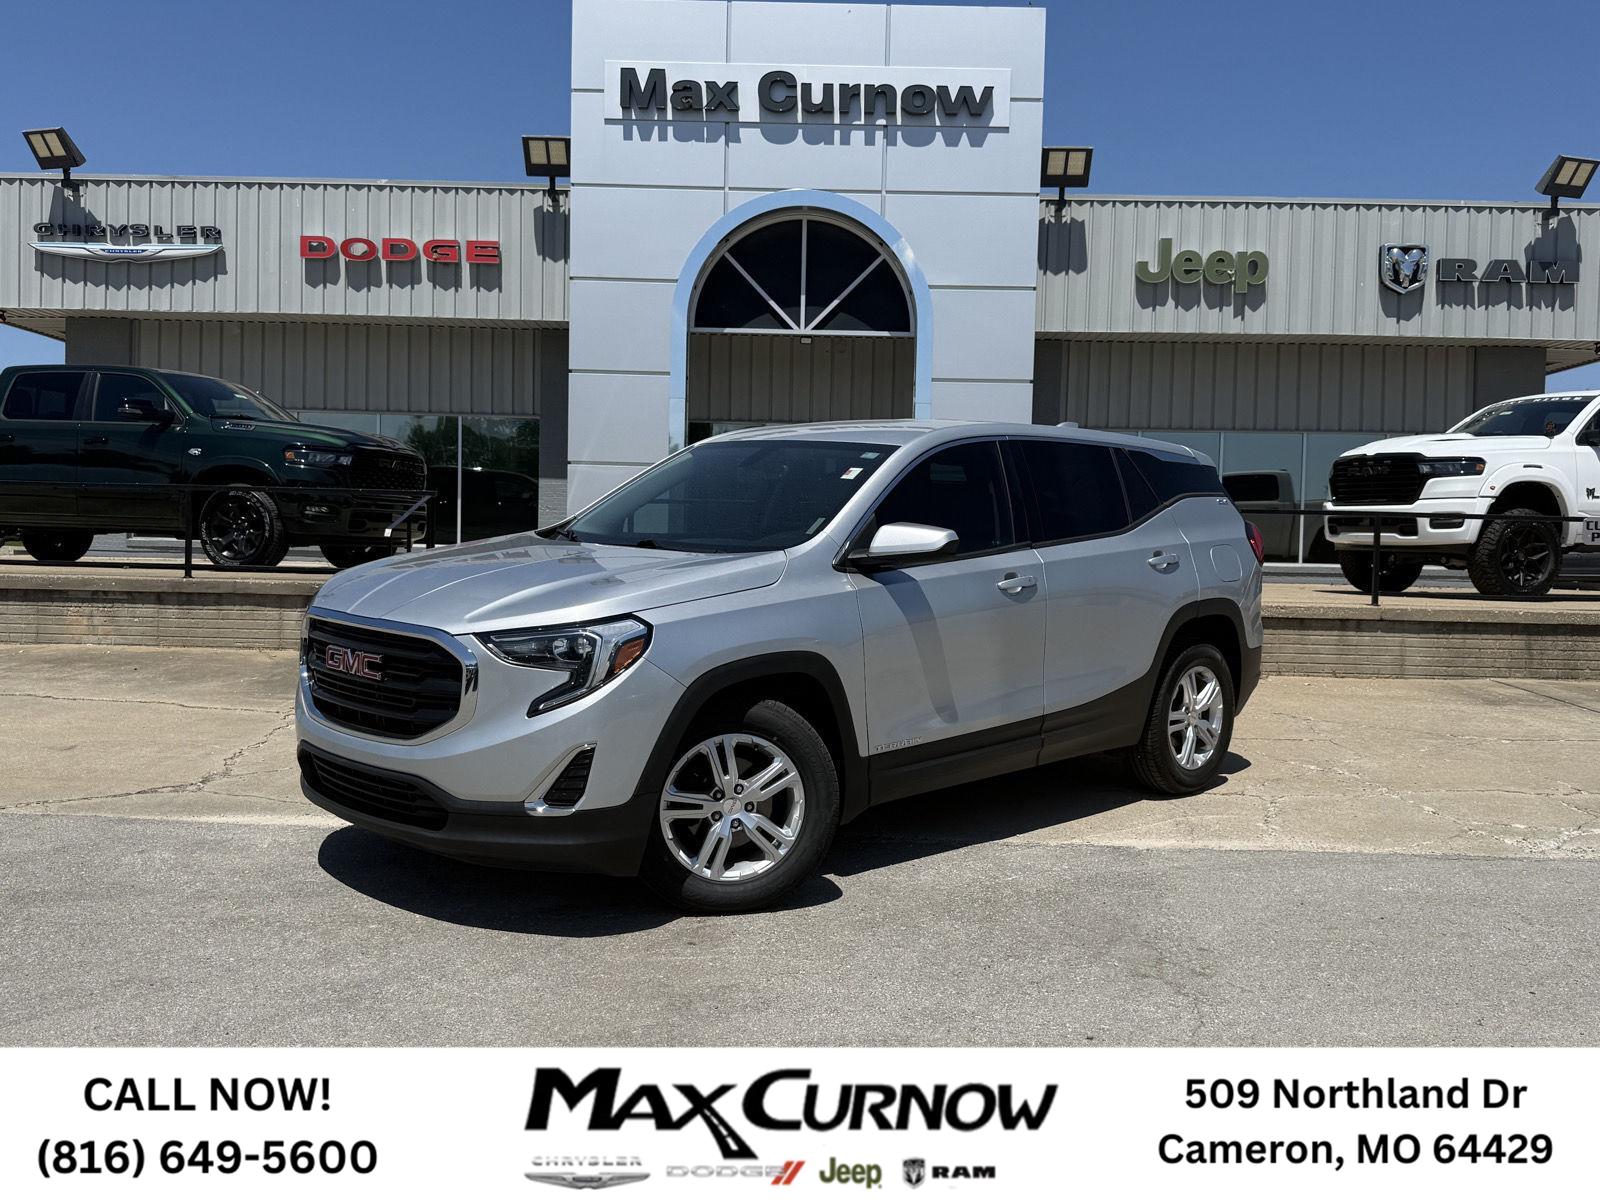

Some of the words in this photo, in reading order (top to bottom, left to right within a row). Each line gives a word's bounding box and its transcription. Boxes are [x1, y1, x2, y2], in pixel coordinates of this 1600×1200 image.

[620, 67, 739, 113] Max
[758, 70, 994, 116] Curnow
[34, 222, 222, 239] CHRYSLER
[299, 235, 501, 265] DODGE
[1135, 237, 1269, 294] Jeep
[1436, 258, 1580, 284] RAM
[326, 645, 383, 681] GMC
